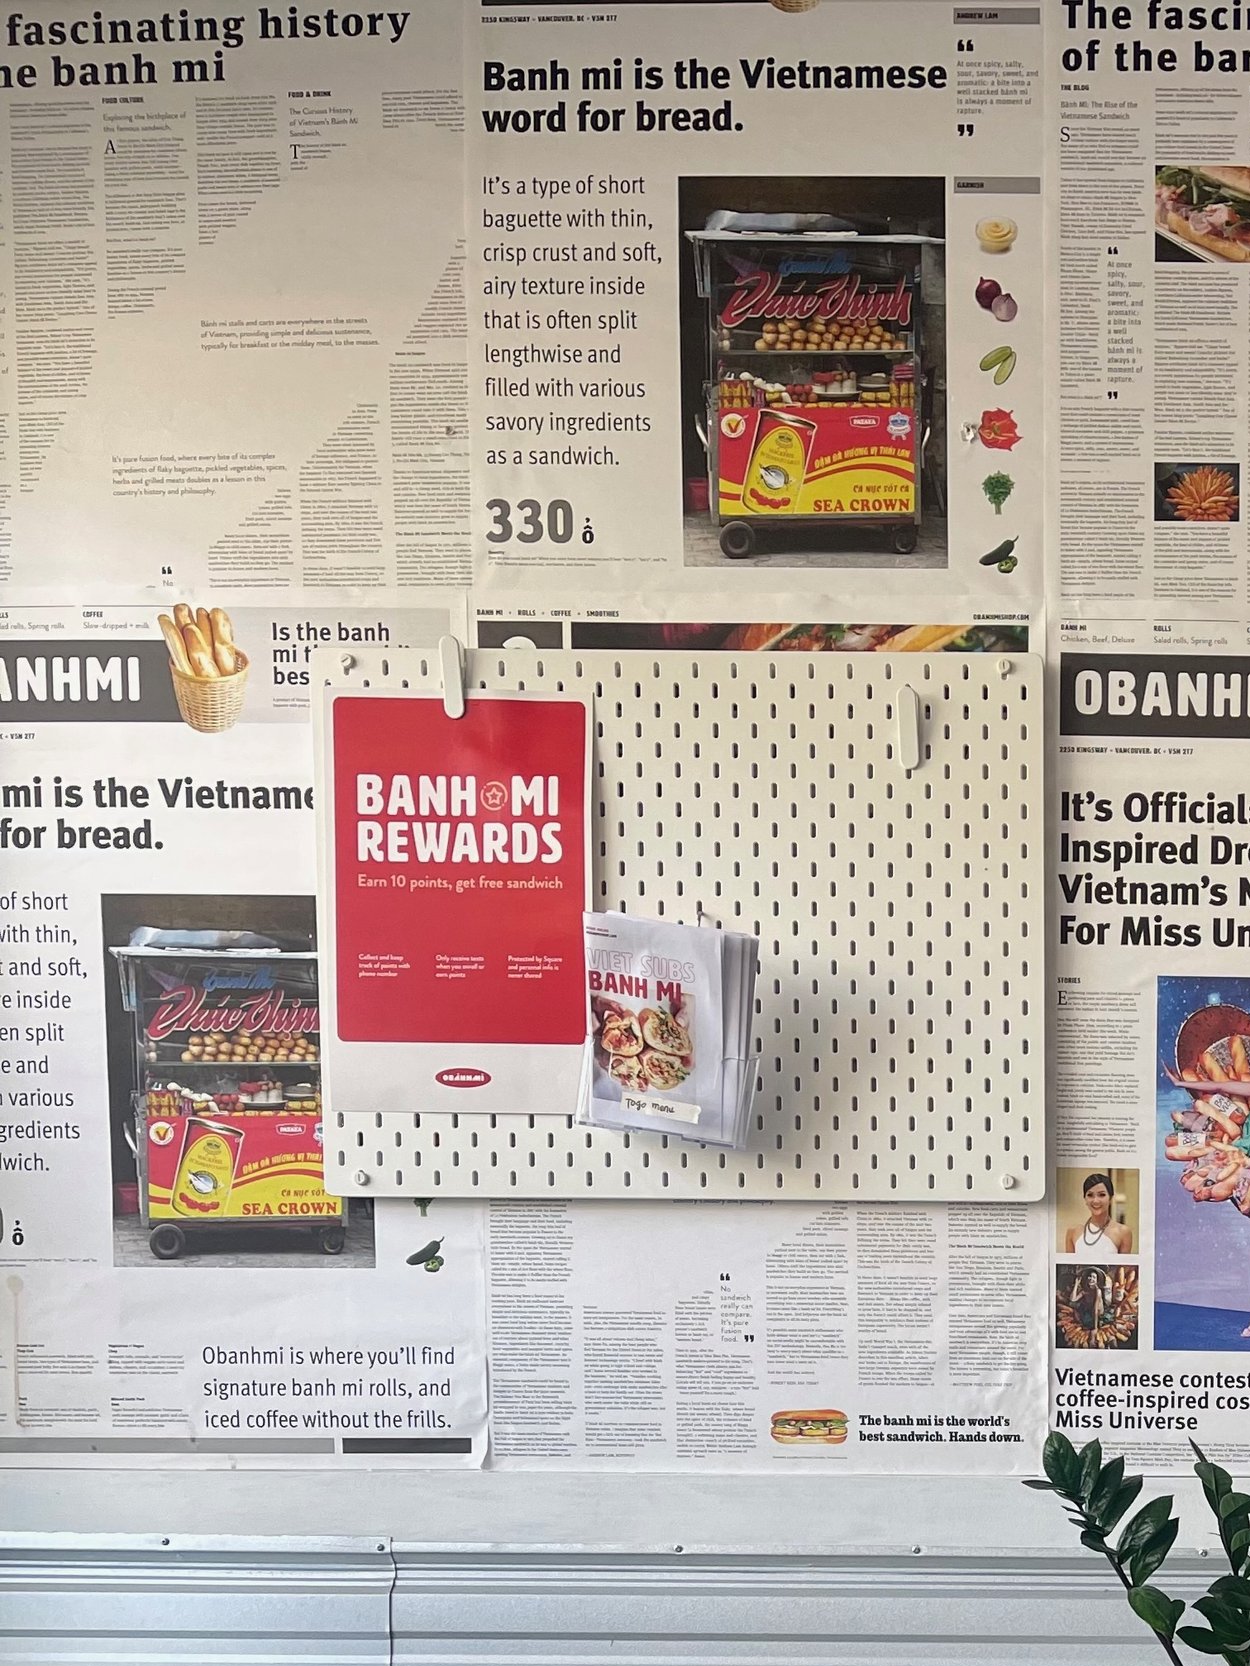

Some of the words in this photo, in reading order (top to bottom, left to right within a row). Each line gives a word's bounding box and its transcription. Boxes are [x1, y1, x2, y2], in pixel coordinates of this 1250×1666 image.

[1062, 0, 1131, 30] The
[6, 9, 245, 48] fascinating
[258, 7, 410, 43] history
[1062, 40, 1100, 71] of
[1115, 40, 1177, 71] the
[51, 53, 157, 86] banh
[172, 50, 225, 82] mi
[484, 60, 569, 91] Banh
[582, 58, 622, 90] mi
[635, 58, 663, 89] is
[674, 58, 730, 89] the
[739, 57, 947, 89] Vietnamese
[482, 101, 566, 133] word
[577, 100, 626, 132] for
[636, 100, 743, 131] bread.
[484, 176, 510, 194] It's
[517, 181, 526, 194] a
[532, 177, 570, 199] type
[576, 175, 594, 194] of
[599, 175, 645, 194] short
[484, 209, 562, 232] baguette
[567, 208, 604, 227] with
[611, 208, 652, 230] thin,
[484, 243, 526, 266] crisp
[533, 244, 577, 261] crust
[583, 242, 615, 261] and
[623, 242, 661, 264] soft,
[484, 276, 516, 299] airy
[522, 278, 584, 295] texture
[590, 276, 645, 295] inside
[484, 310, 520, 329] that
[526, 310, 540, 329] is
[547, 310, 591, 329] often
[598, 310, 637, 334] split
[486, 344, 582, 367] lengthwise
[588, 344, 620, 363] and
[486, 377, 529, 396] filled
[536, 378, 573, 397] with
[579, 378, 645, 397] various
[486, 416, 544, 435] savory
[550, 412, 651, 435] ingredients
[487, 450, 506, 464] as
[513, 451, 522, 464] a
[529, 446, 619, 465] sandwich.
[813, 499, 846, 512] SEA
[849, 499, 909, 512] CROWN
[486, 499, 573, 543] 330
[272, 622, 290, 641] Is
[296, 622, 331, 641] the
[338, 622, 389, 641] banh
[357, 774, 476, 816] BANH
[512, 776, 558, 816] MI
[1061, 791, 1113, 822] It's
[358, 821, 562, 863] REWARDS
[1061, 832, 1198, 872] Inspired
[358, 874, 387, 887] Earn
[391, 875, 406, 887] 10
[410, 875, 452, 892] points,
[456, 878, 475, 893] get
[479, 875, 503, 888] free
[507, 876, 563, 888] sandwich
[1058, 872, 1227, 906] Vietnam's
[1060, 915, 1110, 945] For
[1121, 915, 1201, 947] Miss
[587, 948, 632, 973] VIET
[641, 955, 695, 983] SUBS
[588, 970, 647, 999] BANH
[657, 981, 683, 1003] MI
[625, 1098, 647, 1111] Togo
[652, 1103, 675, 1113] menu
[203, 1346, 283, 1364] Obanhmi
[290, 1347, 304, 1364] is
[310, 1346, 363, 1364] where
[367, 1347, 416, 1369] you'll
[422, 1346, 454, 1364] find
[204, 1378, 286, 1400] signature
[292, 1378, 335, 1396] banh
[343, 1379, 362, 1396] mi
[419, 1378, 450, 1396] and
[1055, 1368, 1173, 1387] Vietnamese
[1056, 1389, 1208, 1413] coffee-inspired
[205, 1410, 240, 1428] iced
[247, 1410, 298, 1428] coffee
[302, 1410, 369, 1428] without
[374, 1410, 402, 1428] the
[407, 1410, 451, 1428] frills.
[859, 1415, 881, 1426] The
[883, 1415, 914, 1426] banh
[916, 1415, 932, 1426] mi
[934, 1415, 944, 1426] is
[946, 1415, 966, 1427] the
[967, 1415, 1010, 1427] world's
[1056, 1410, 1102, 1428] Miss
[1110, 1411, 1197, 1430] Universe
[859, 1431, 885, 1441] best
[887, 1431, 946, 1442] sandwich.
[949, 1431, 987, 1442] Hands
[989, 1431, 1024, 1442] down.
